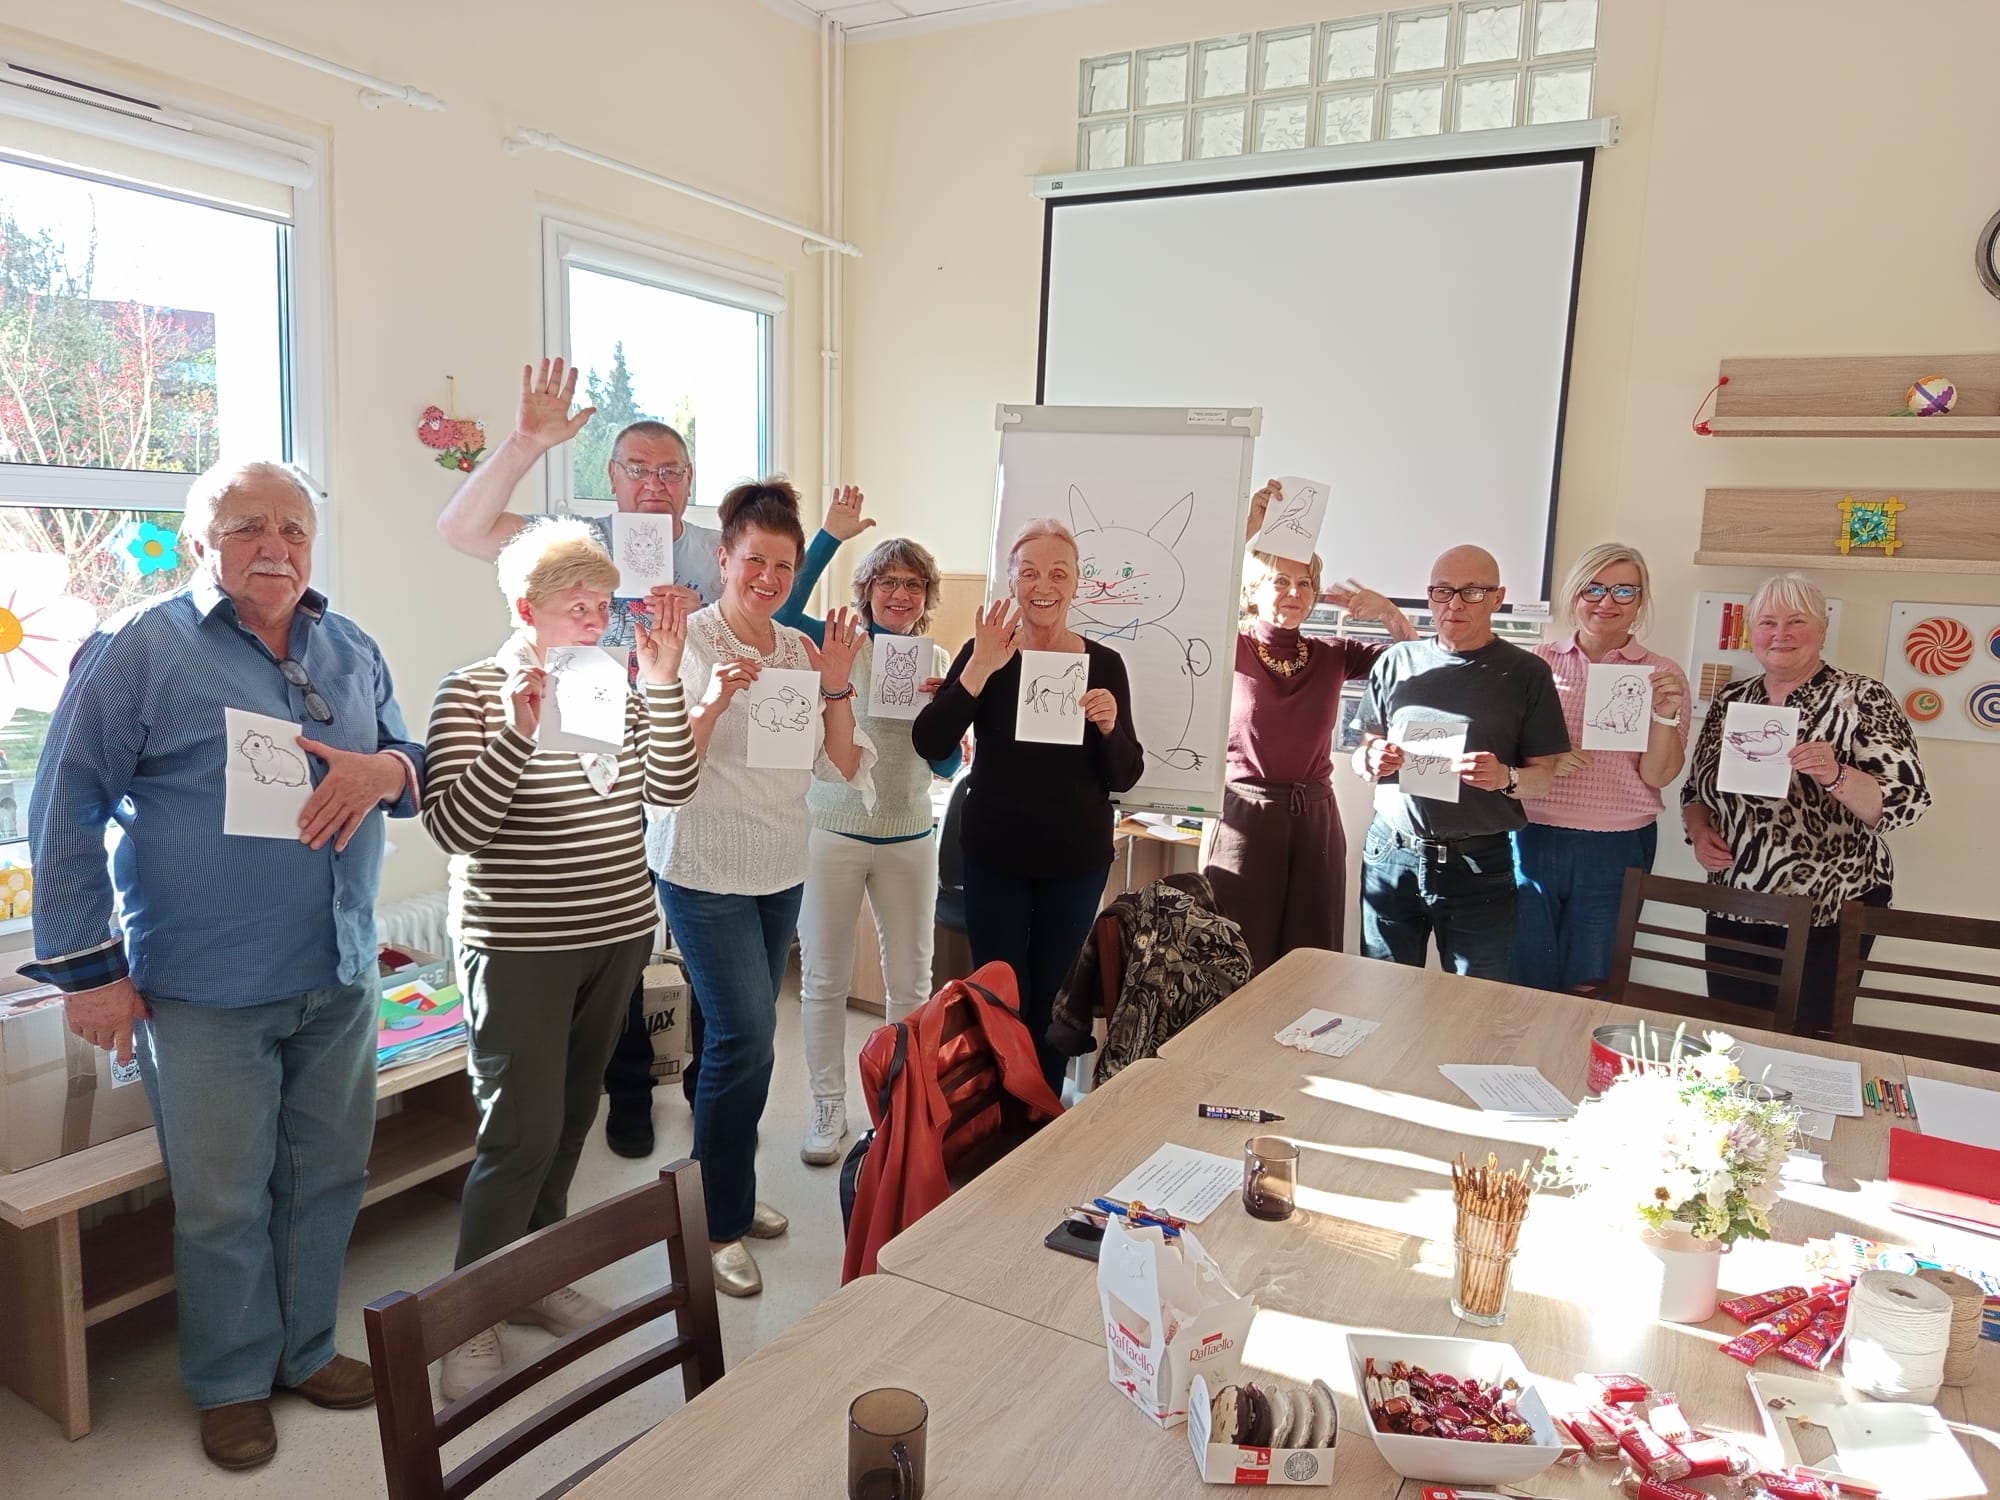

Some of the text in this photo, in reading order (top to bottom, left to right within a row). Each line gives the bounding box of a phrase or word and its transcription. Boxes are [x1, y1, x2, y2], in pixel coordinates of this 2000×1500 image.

[1206, 1106, 1260, 1117] MARKER
[1108, 1322, 1155, 1376] Raffaello
[1189, 1339, 1234, 1362] Raffaello
[1646, 1476, 1698, 1500] Biscoff
[1765, 1476, 1816, 1492] Biscoff
